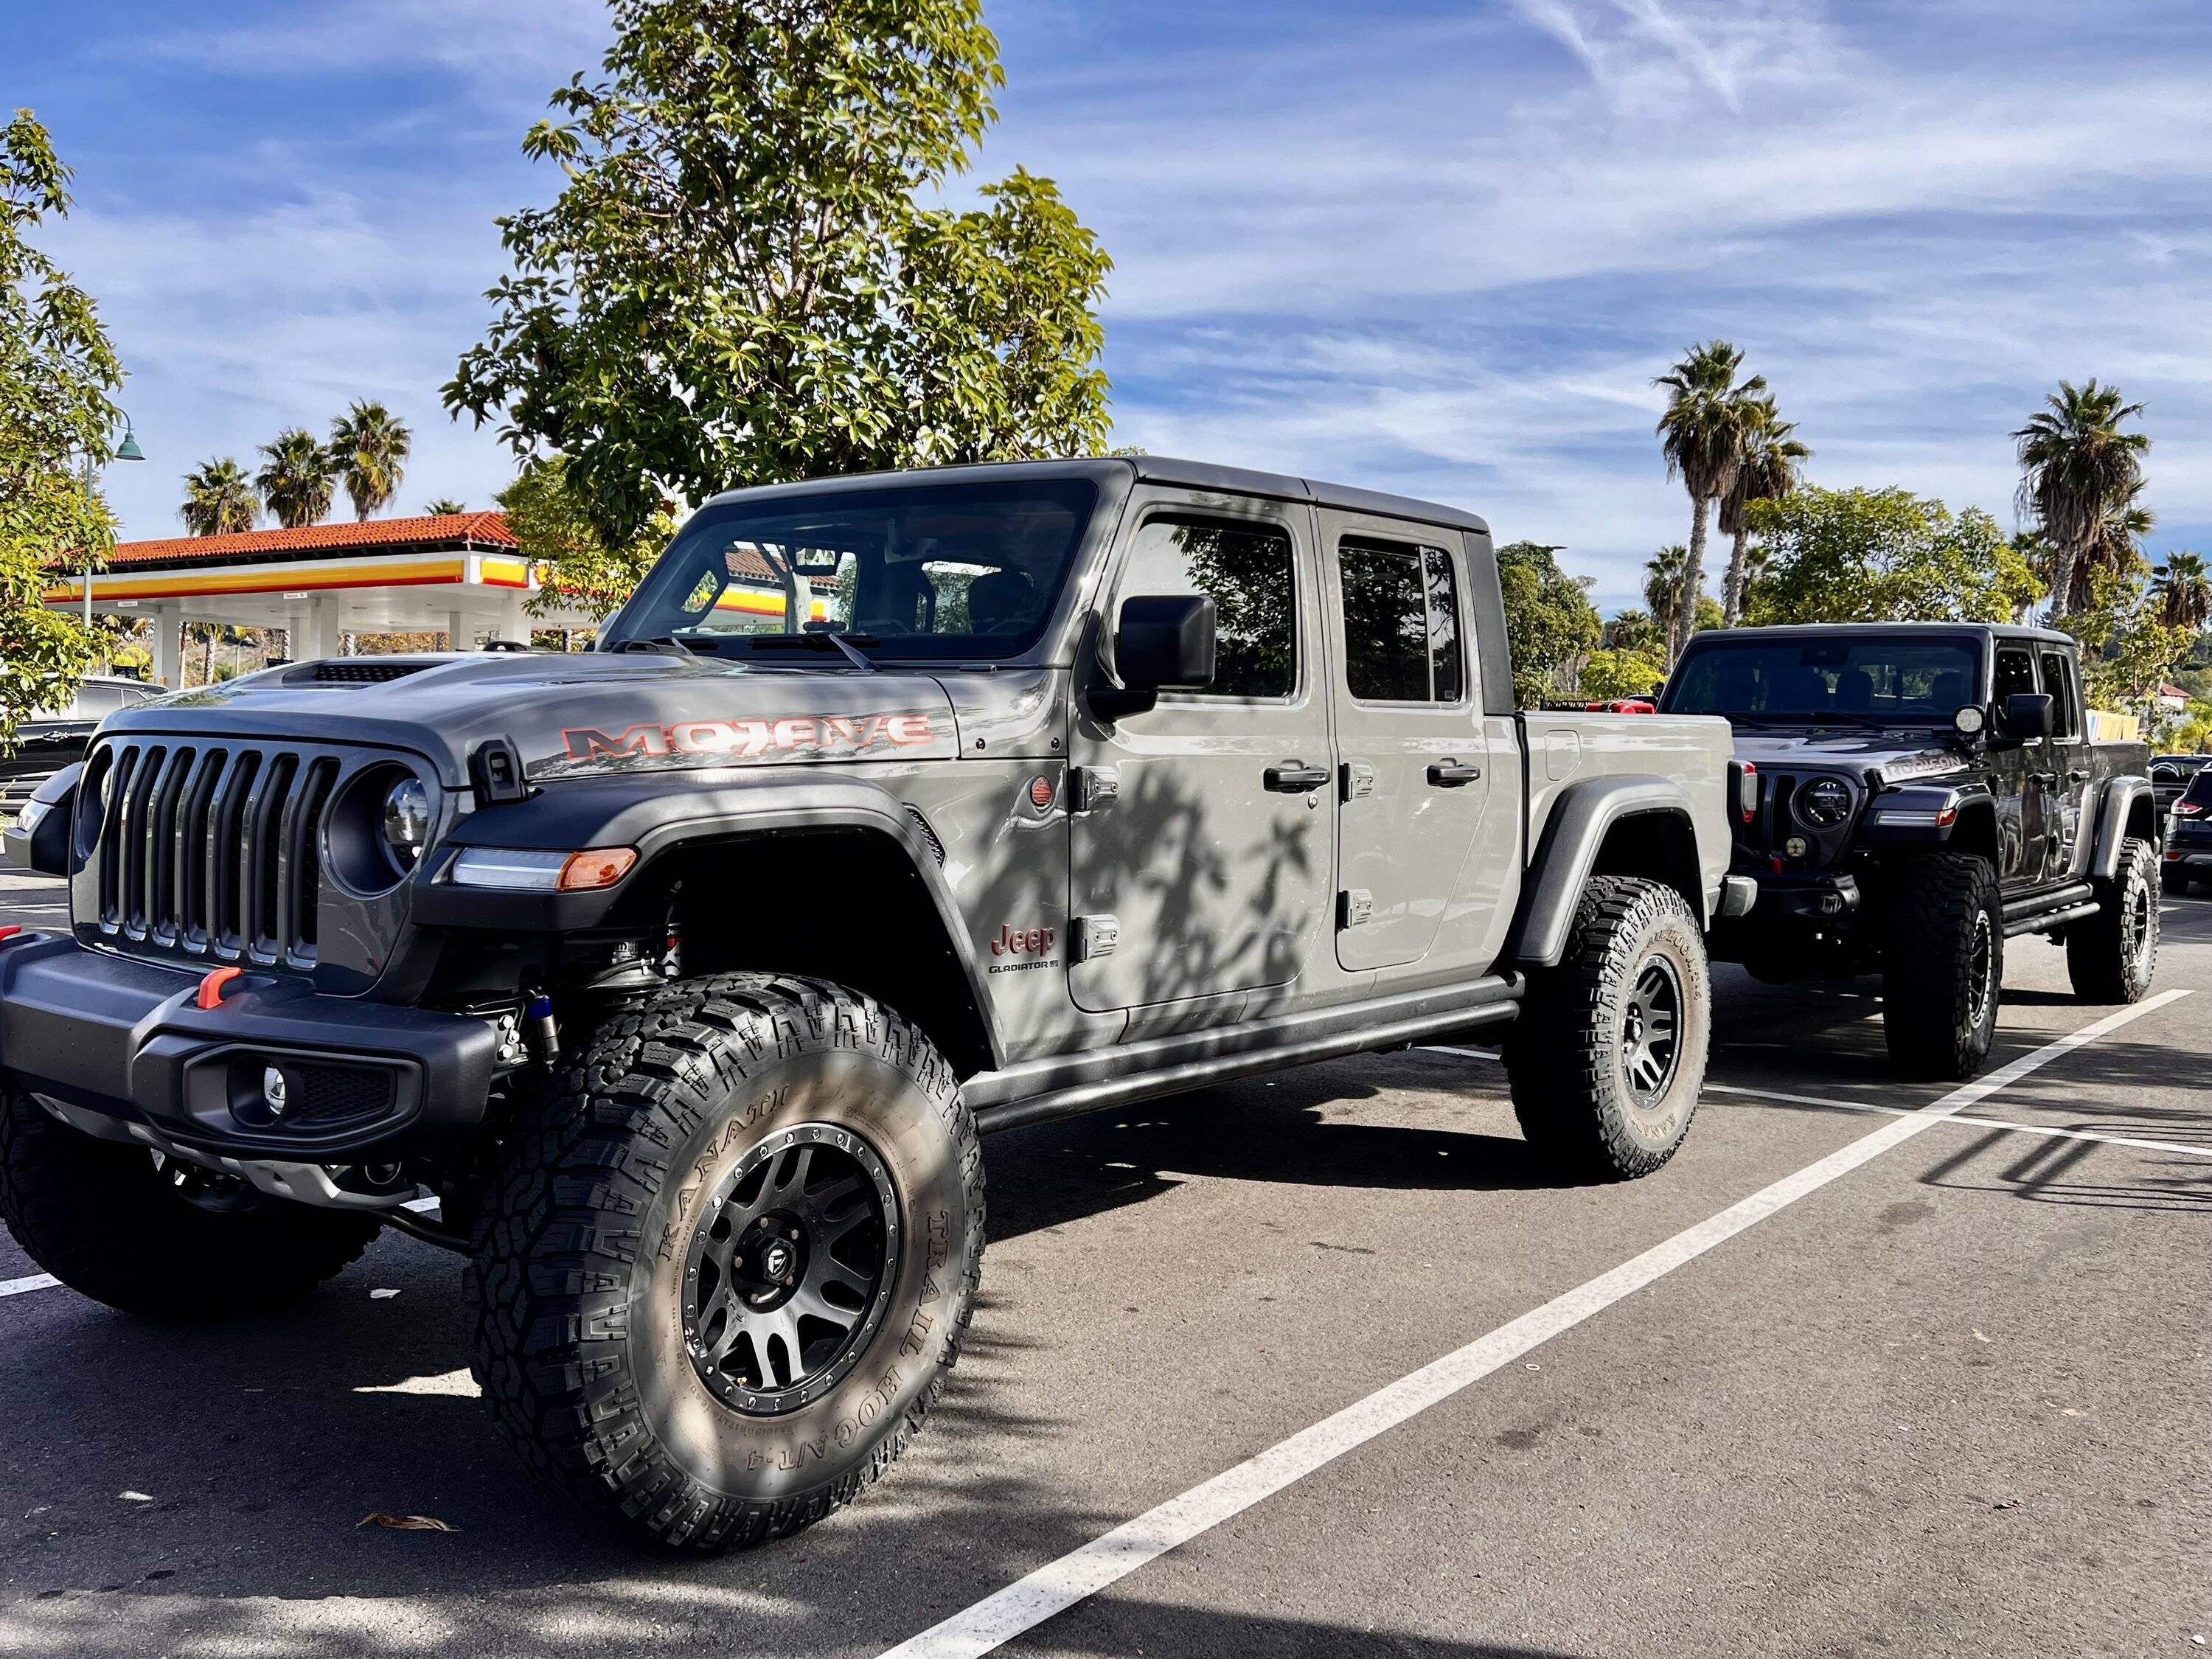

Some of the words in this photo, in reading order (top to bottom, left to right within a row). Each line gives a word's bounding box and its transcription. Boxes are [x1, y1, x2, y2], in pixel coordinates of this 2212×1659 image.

[562, 715, 935, 759] MOJAVE
[1884, 754, 1961, 777] RUBICON
[991, 923, 1055, 957] Jeep
[1666, 929, 1691, 956] HOG
[989, 961, 1048, 973] GLADIATOR
[658, 1084, 788, 1262] KANATI
[900, 1209, 949, 1357] TRAIL
[834, 1365, 904, 1448] HOG
[748, 1435, 828, 1470] A/T-4
